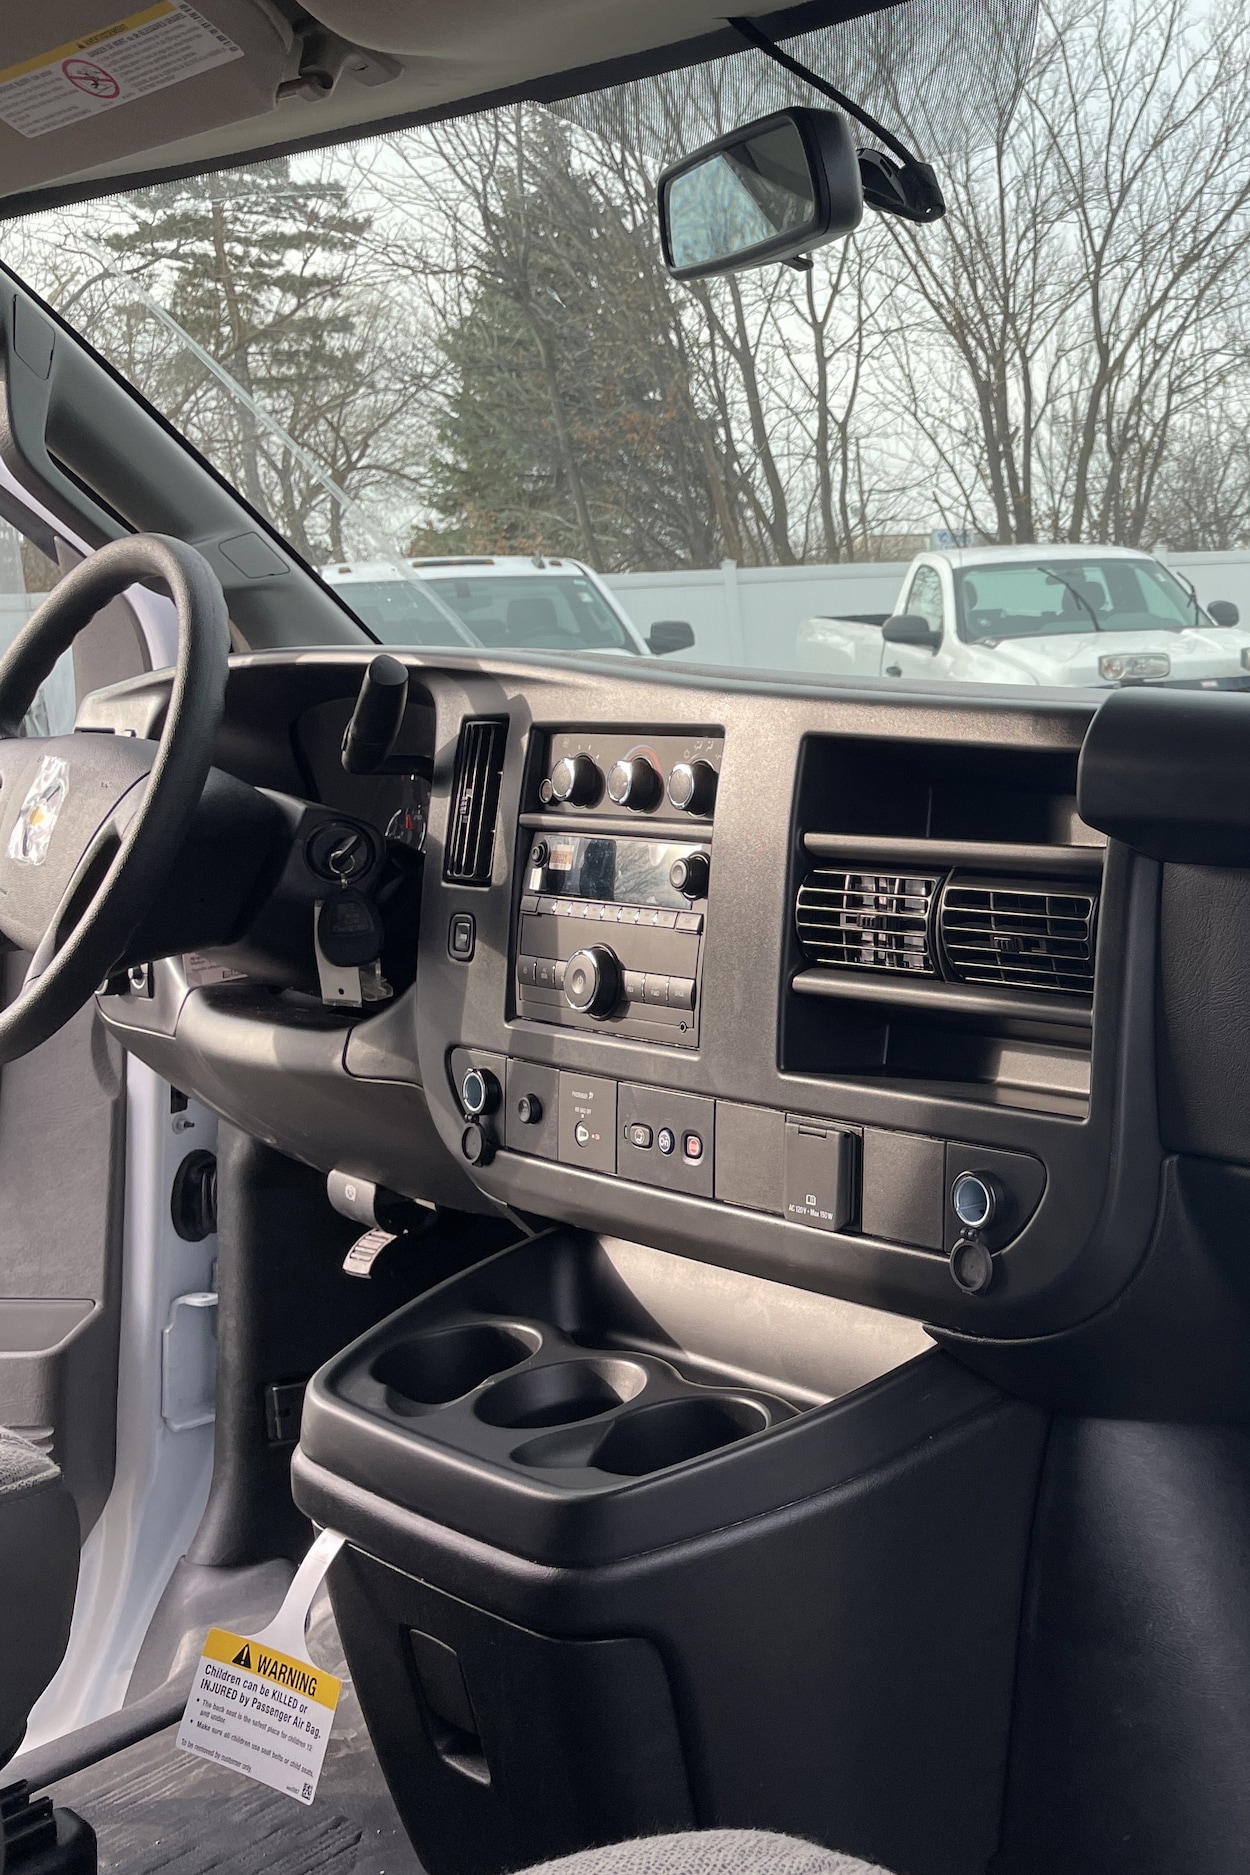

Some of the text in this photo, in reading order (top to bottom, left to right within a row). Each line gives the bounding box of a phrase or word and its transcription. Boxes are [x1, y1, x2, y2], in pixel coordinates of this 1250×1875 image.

[204, 1664, 308, 1714] Children can be KILLED or
[257, 1653, 318, 1697] WARNING
[200, 1678, 321, 1739] INJURED by Passenger Air Bag.
[202, 1699, 212, 1710] The
[212, 1703, 225, 1714] back
[196, 1721, 211, 1732] Make
[231, 1733, 251, 1747] children
